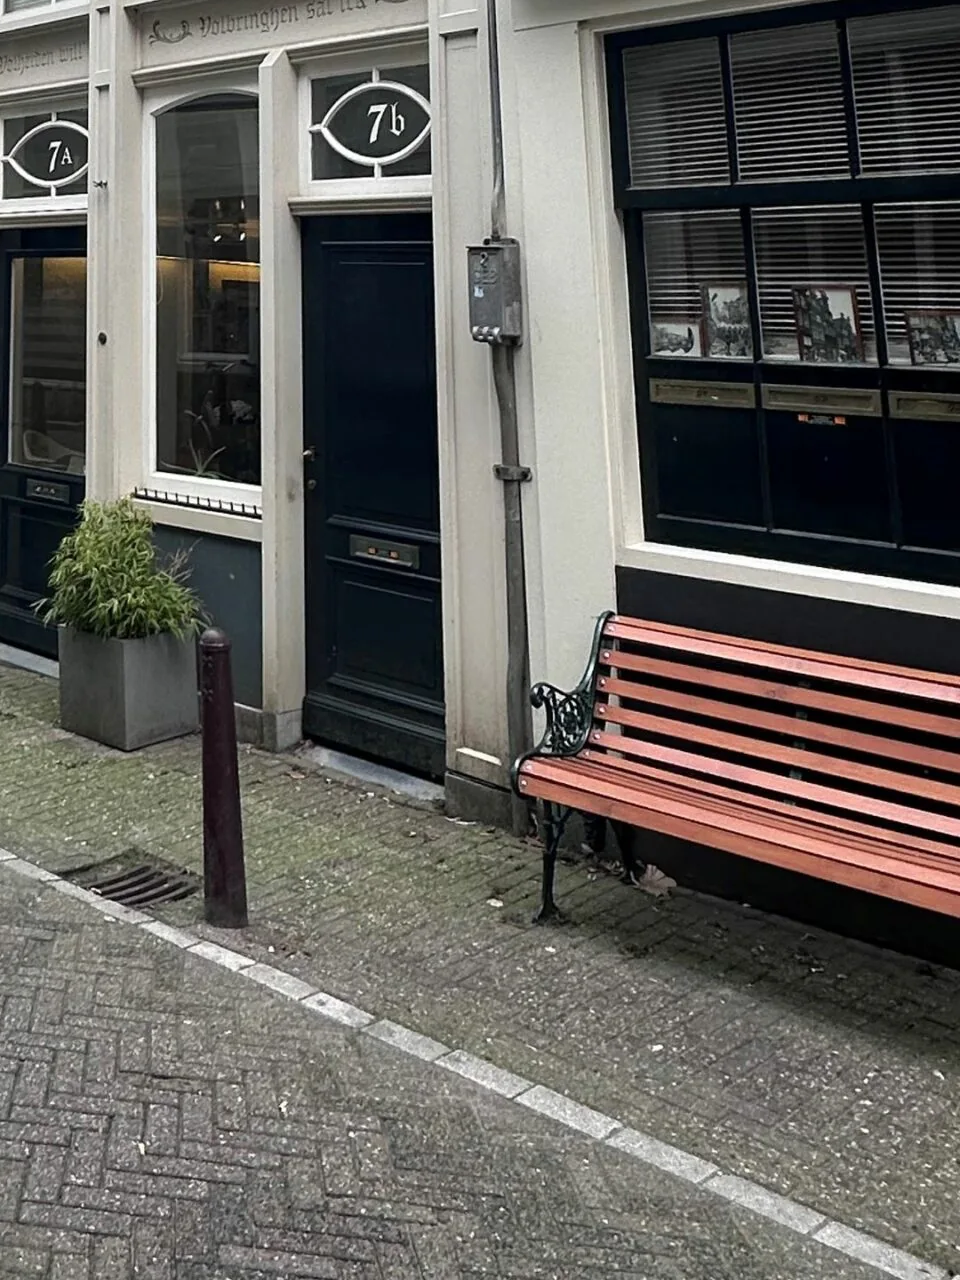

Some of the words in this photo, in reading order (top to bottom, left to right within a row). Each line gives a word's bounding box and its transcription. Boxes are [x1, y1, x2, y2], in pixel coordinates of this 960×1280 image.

[199, 4, 299, 38] Volbringhen
[366, 101, 405, 144] 7b
[48, 140, 73, 173] 7A
